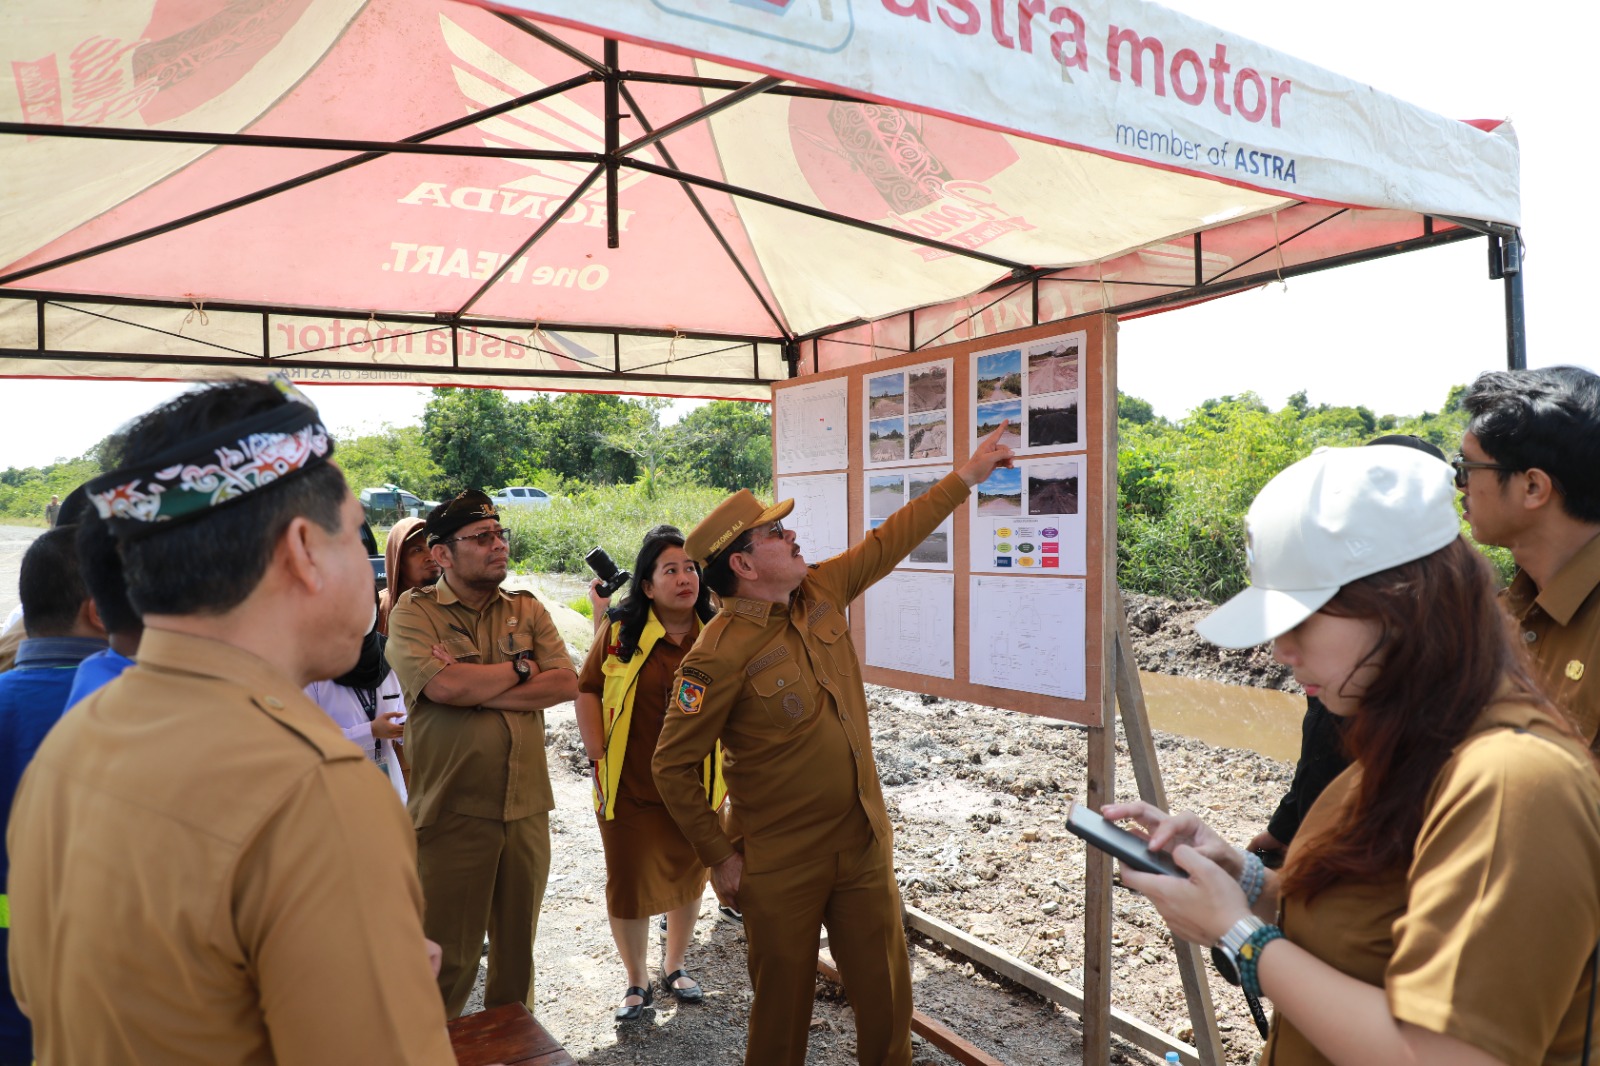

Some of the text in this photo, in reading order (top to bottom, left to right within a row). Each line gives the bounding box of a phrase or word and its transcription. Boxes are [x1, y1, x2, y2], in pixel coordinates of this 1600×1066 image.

[1107, 24, 1291, 129] motor
[1116, 123, 1297, 184] member of ASTRA
[732, 520, 745, 532] ALA
